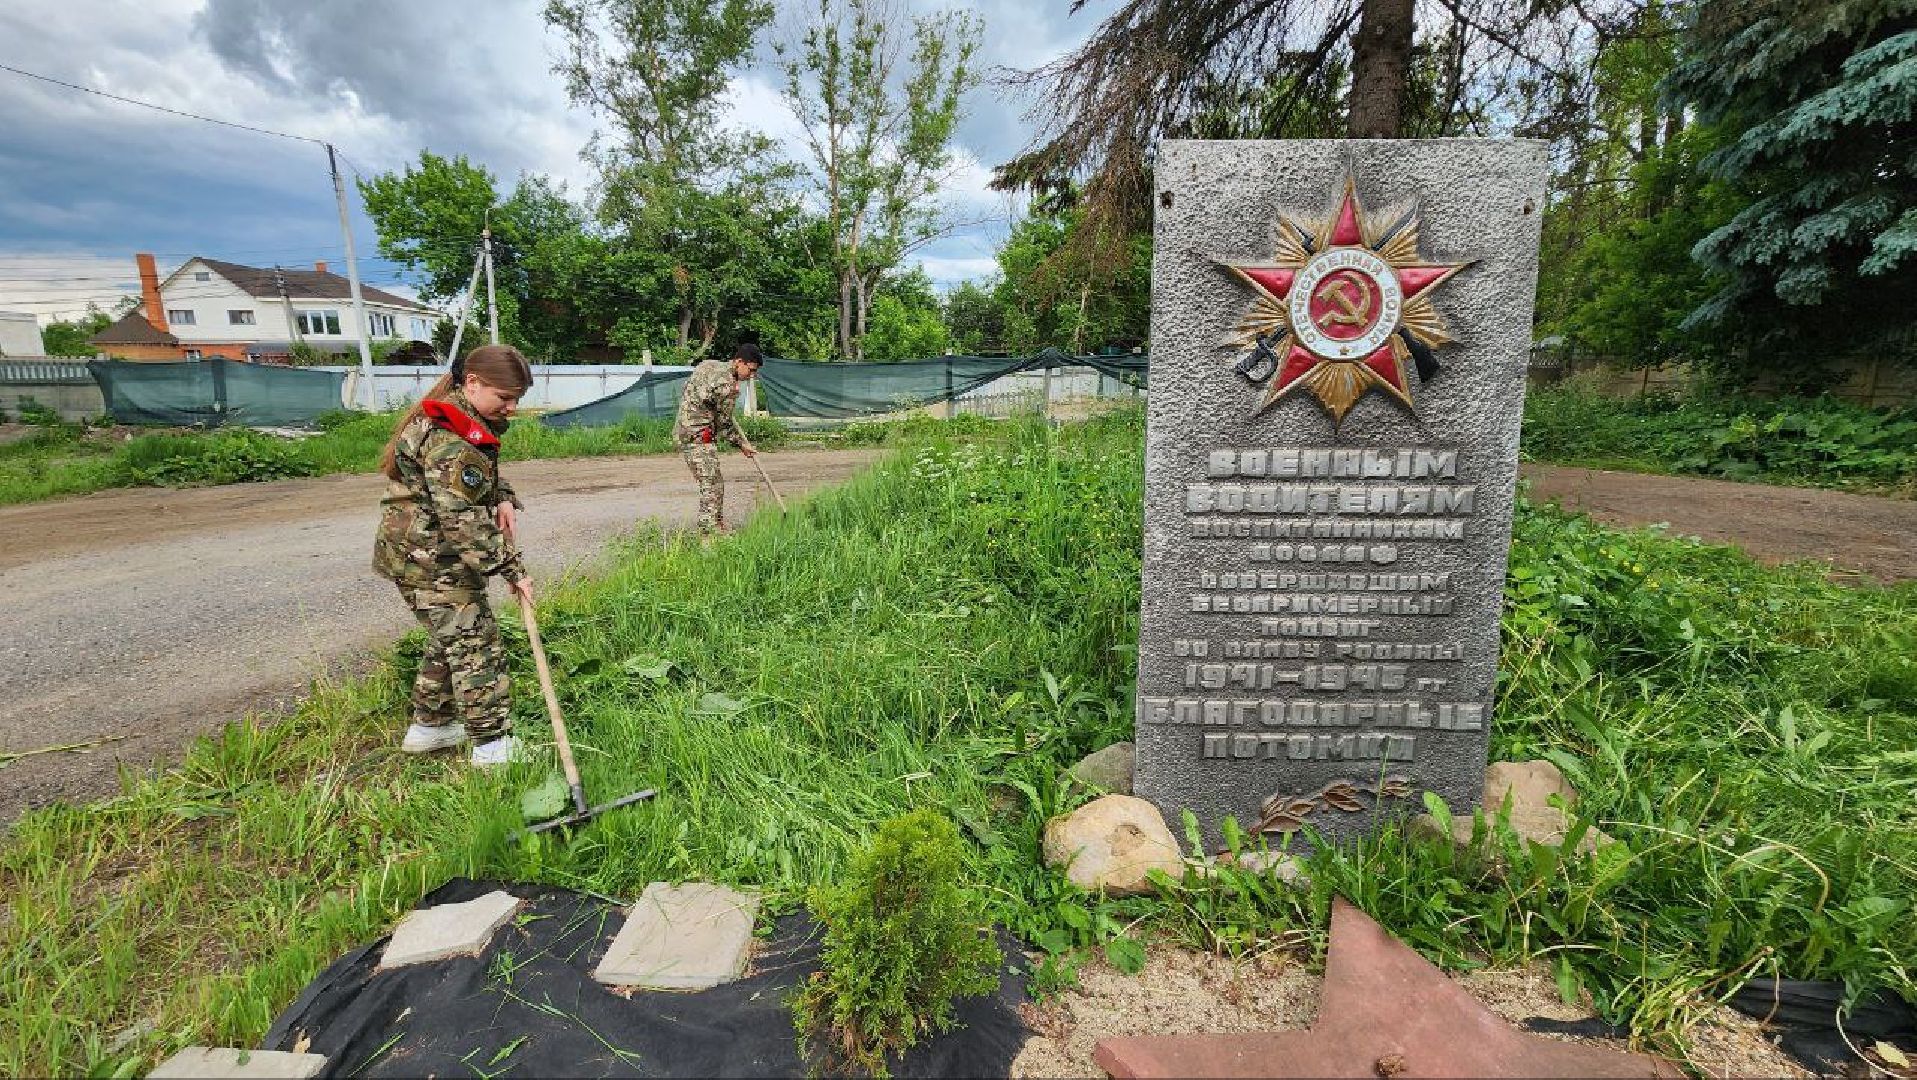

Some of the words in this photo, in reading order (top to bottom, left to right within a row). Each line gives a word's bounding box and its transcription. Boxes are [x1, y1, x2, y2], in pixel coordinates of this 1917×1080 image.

[1208, 449, 1459, 478] ВОЕННЫМ
[1186, 485, 1476, 514] ВОДИТЕЛЯМ
[1191, 521, 1464, 540] ВОСПИТАННИКАМ
[1252, 545, 1399, 564] ДОСААФ
[1201, 573, 1449, 591] СОВЕРШИВШИМ
[1261, 620, 1380, 637] ПОДВИГ
[1173, 639, 1209, 657] ВО
[1224, 641, 1320, 659] СЛАВУ
[1336, 643, 1464, 661] РОДИНЫ
[1142, 698, 1484, 730] БЛАГОДАРНЫЕ
[1203, 734, 1416, 760] ПОТОМКИ
